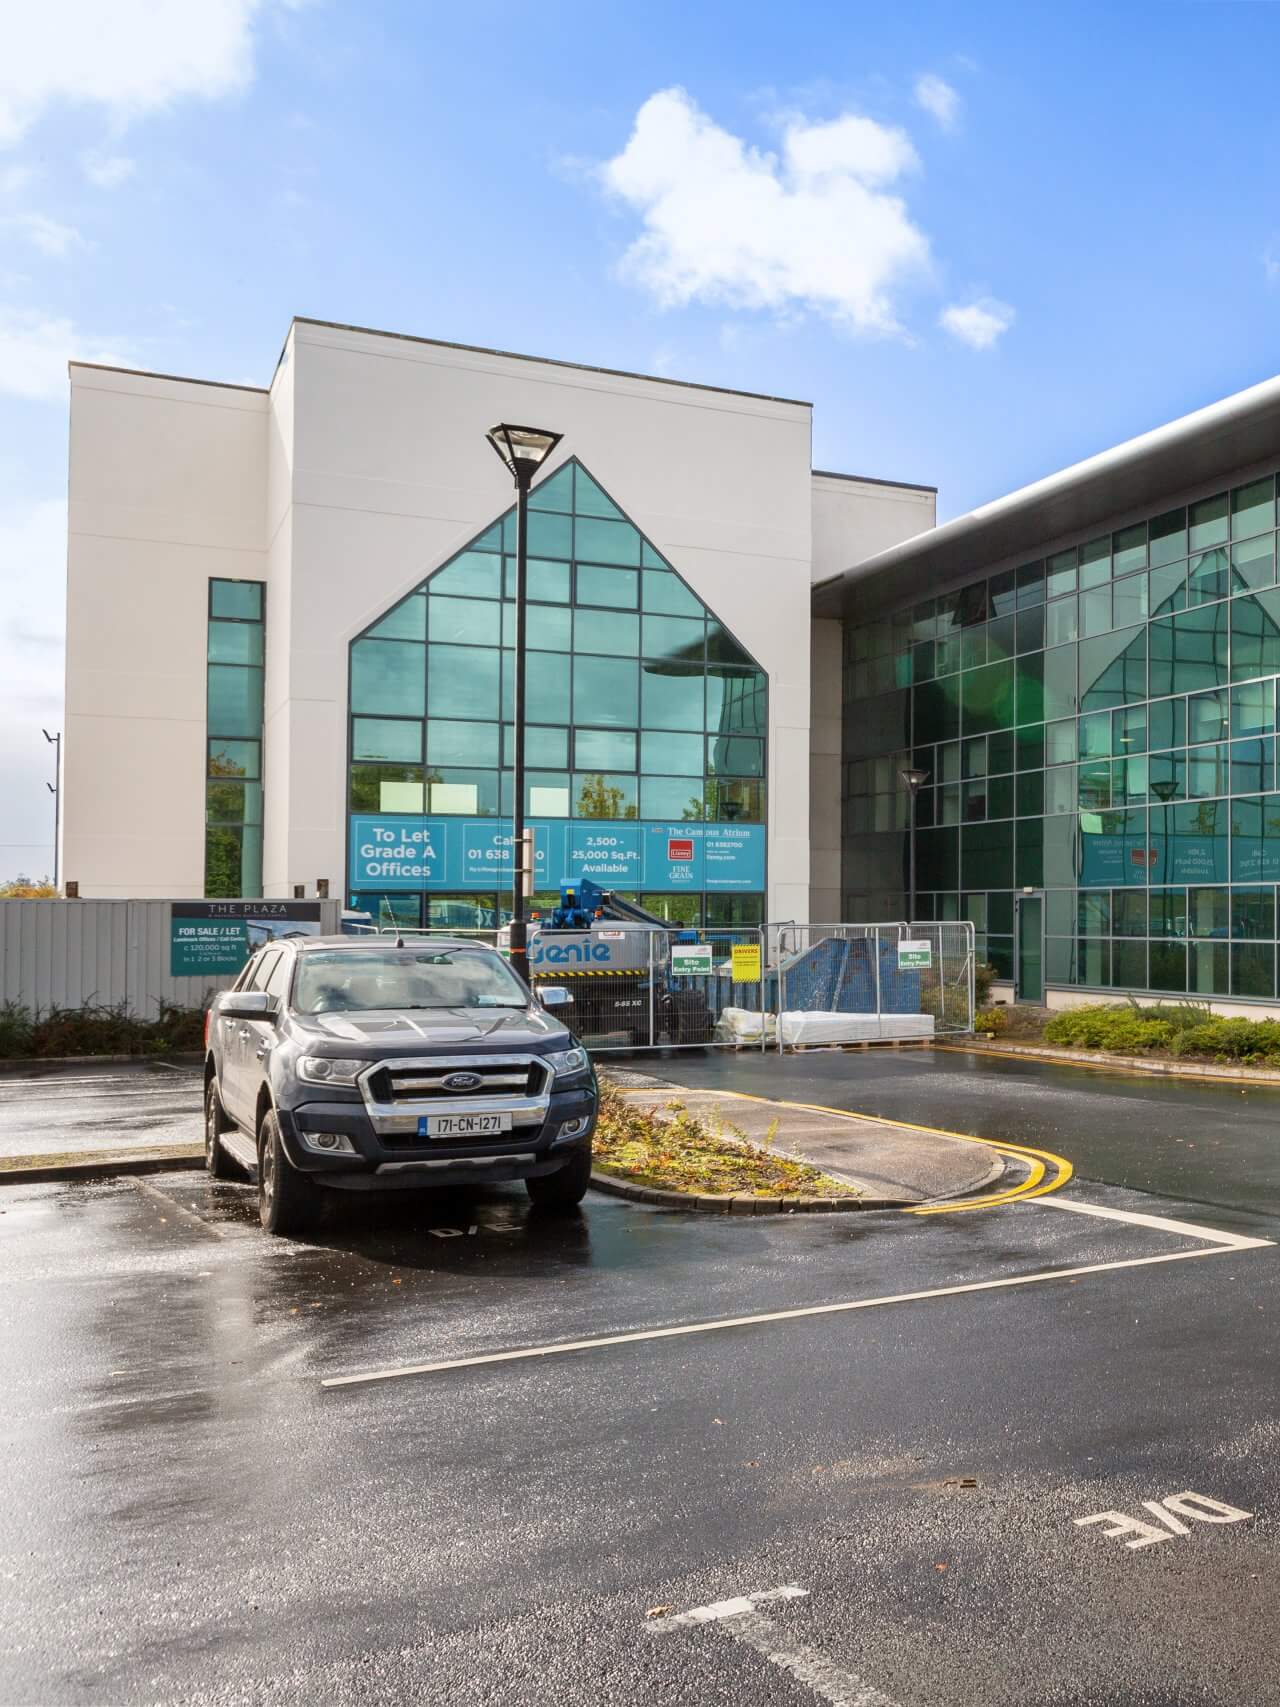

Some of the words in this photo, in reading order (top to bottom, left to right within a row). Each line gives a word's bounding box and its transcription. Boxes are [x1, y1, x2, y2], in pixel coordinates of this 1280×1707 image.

[372, 828, 395, 842] To
[401, 828, 430, 842] Let
[586, 837, 617, 847] 2,500
[360, 844, 416, 858] Grade
[423, 845, 436, 858] A
[468, 849, 481, 859] 01
[486, 849, 509, 859] 638
[572, 850, 608, 860] 25,000
[611, 851, 640, 861] Sq.Ft.
[366, 862, 431, 876] Offices
[582, 863, 629, 873] Available
[673, 865, 690, 873] FINE
[208, 904, 236, 913] THE
[244, 904, 288, 914] PLAZA
[179, 927, 196, 936] FOR
[197, 927, 218, 936] SALE
[225, 927, 240, 935] LET
[526, 938, 611, 964] Genie
[438, 1116, 501, 1133] 171-CN-1271
